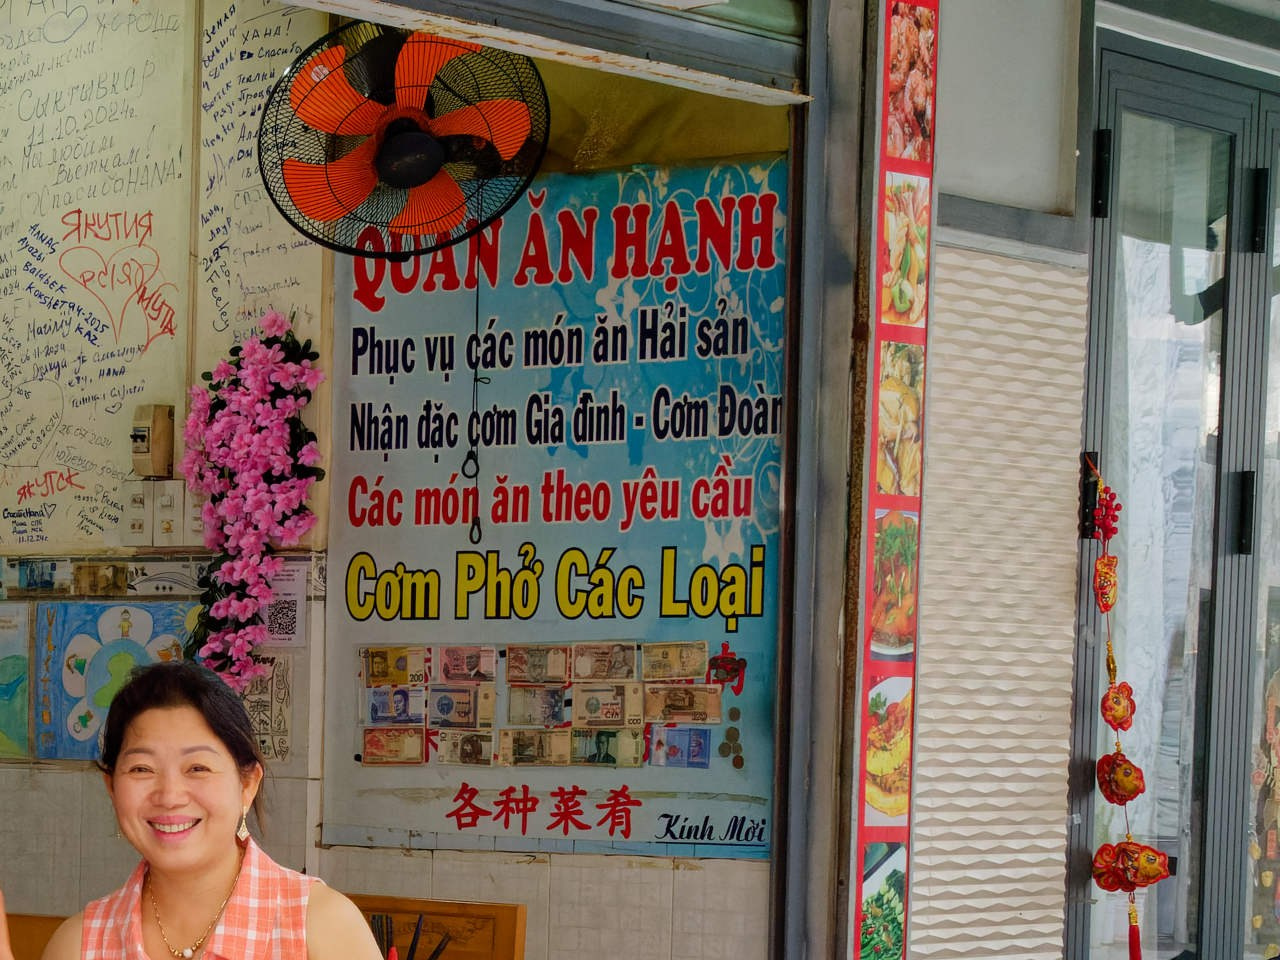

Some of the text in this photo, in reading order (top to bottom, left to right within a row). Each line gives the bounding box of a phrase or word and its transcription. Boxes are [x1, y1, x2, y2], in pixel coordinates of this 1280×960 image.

[61, 208, 154, 248] ЯКУТИЯ
[514, 188, 600, 288] ĂN
[611, 192, 779, 293] HẠNH
[351, 297, 749, 385] Phục vụ các món ăn Hải sản
[349, 402, 409, 463] Nhận
[416, 401, 460, 464] đặc
[469, 404, 517, 448] cơm
[525, 393, 565, 446] Gia
[572, 391, 626, 443] đình
[652, 386, 710, 440] Cơm
[717, 382, 783, 438] Đoàn
[16, 467, 86, 505] ЯКУТСК
[348, 455, 754, 532] Các món ăn theo yêu cầu
[344, 551, 440, 622] Cơm
[454, 541, 544, 621] Phở
[555, 546, 645, 621] Các
[658, 544, 766, 634] Loại
[445, 782, 644, 840] 各种菜肴
[656, 812, 767, 843] Kính Mời
